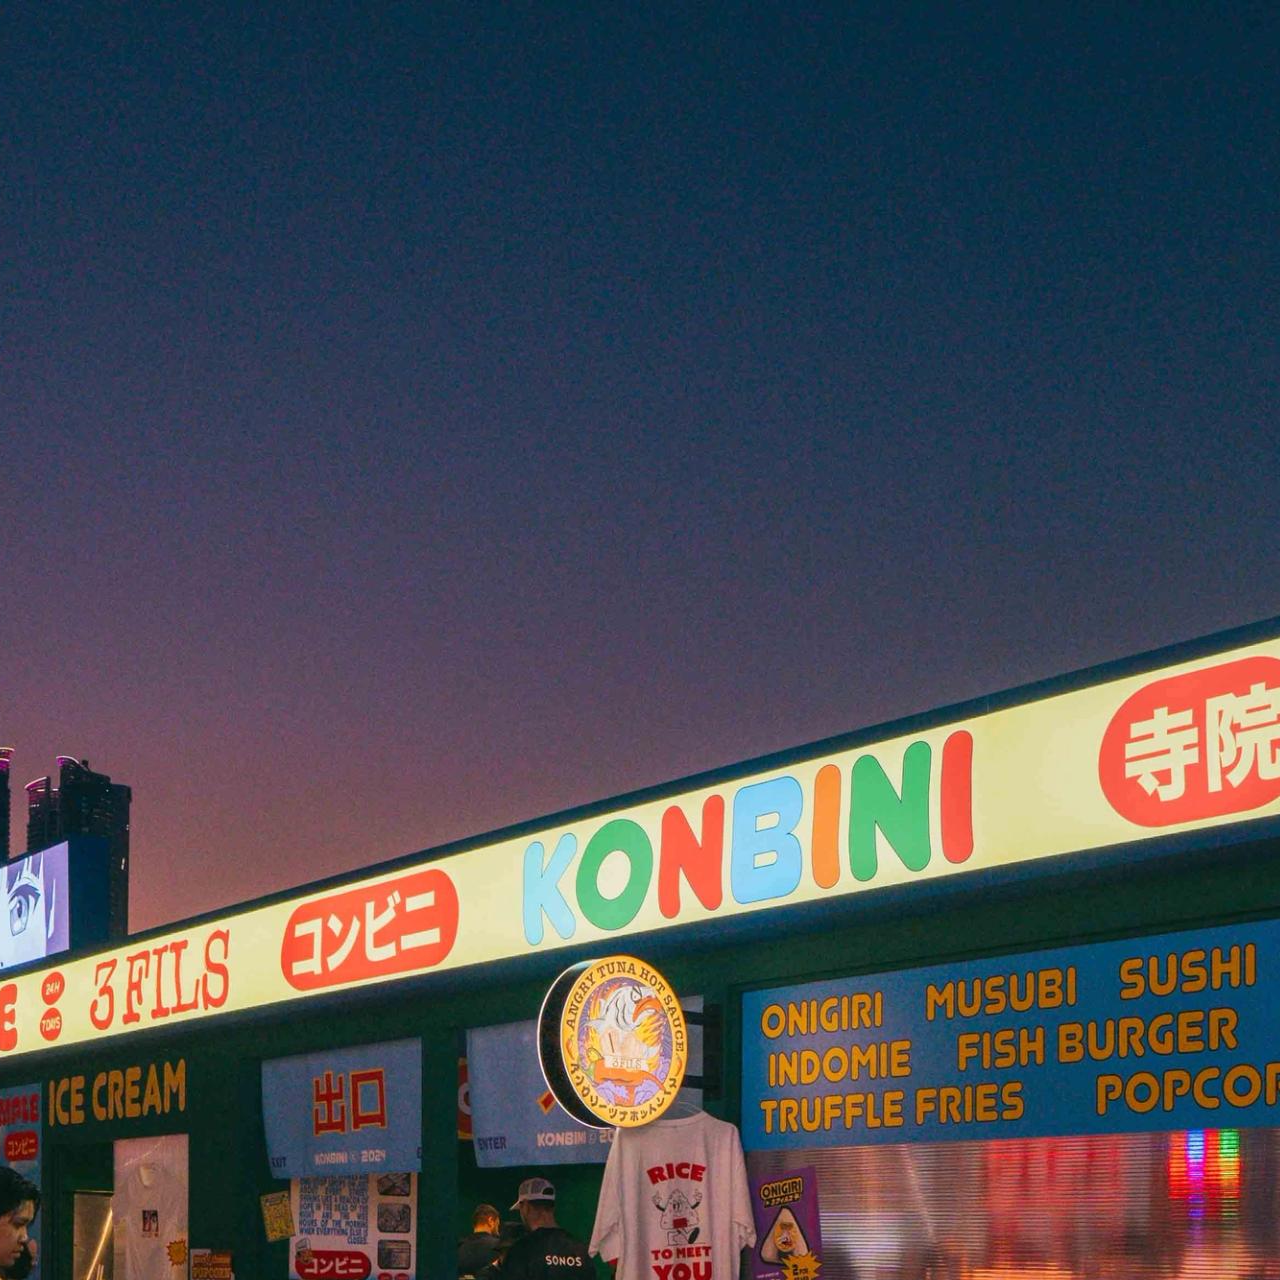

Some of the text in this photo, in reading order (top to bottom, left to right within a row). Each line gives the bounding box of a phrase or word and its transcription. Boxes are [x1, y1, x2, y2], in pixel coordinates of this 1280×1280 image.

[522, 730, 974, 946] KONBINI
[290, 890, 441, 974] コンビニ
[566, 961, 685, 1052] ANGRY TUNA HOT SAUCE
[760, 991, 883, 1039] ONIGIRI
[925, 966, 1077, 1022] MUSUBI
[1118, 943, 1257, 1000] SUSHI
[768, 1040, 912, 1088] INDOMIE
[957, 1027, 1045, 1072] FISH
[1057, 1007, 1239, 1064] BURGER
[48, 1058, 187, 1127] ICE CREAM
[312, 1068, 387, 1136] 出口
[760, 1090, 904, 1135] TRUFFLE
[915, 1081, 1025, 1126] FRIES
[477, 1136, 507, 1151] ENTER
[536, 1129, 613, 1148] KONBINI 20
[647, 1162, 707, 1185] RICE
[761, 1177, 803, 1200] ONIGIRI
[303, 1256, 364, 1275] コンビニ
[545, 1255, 583, 1267] SONOS
[651, 1246, 712, 1261] TO MEET
